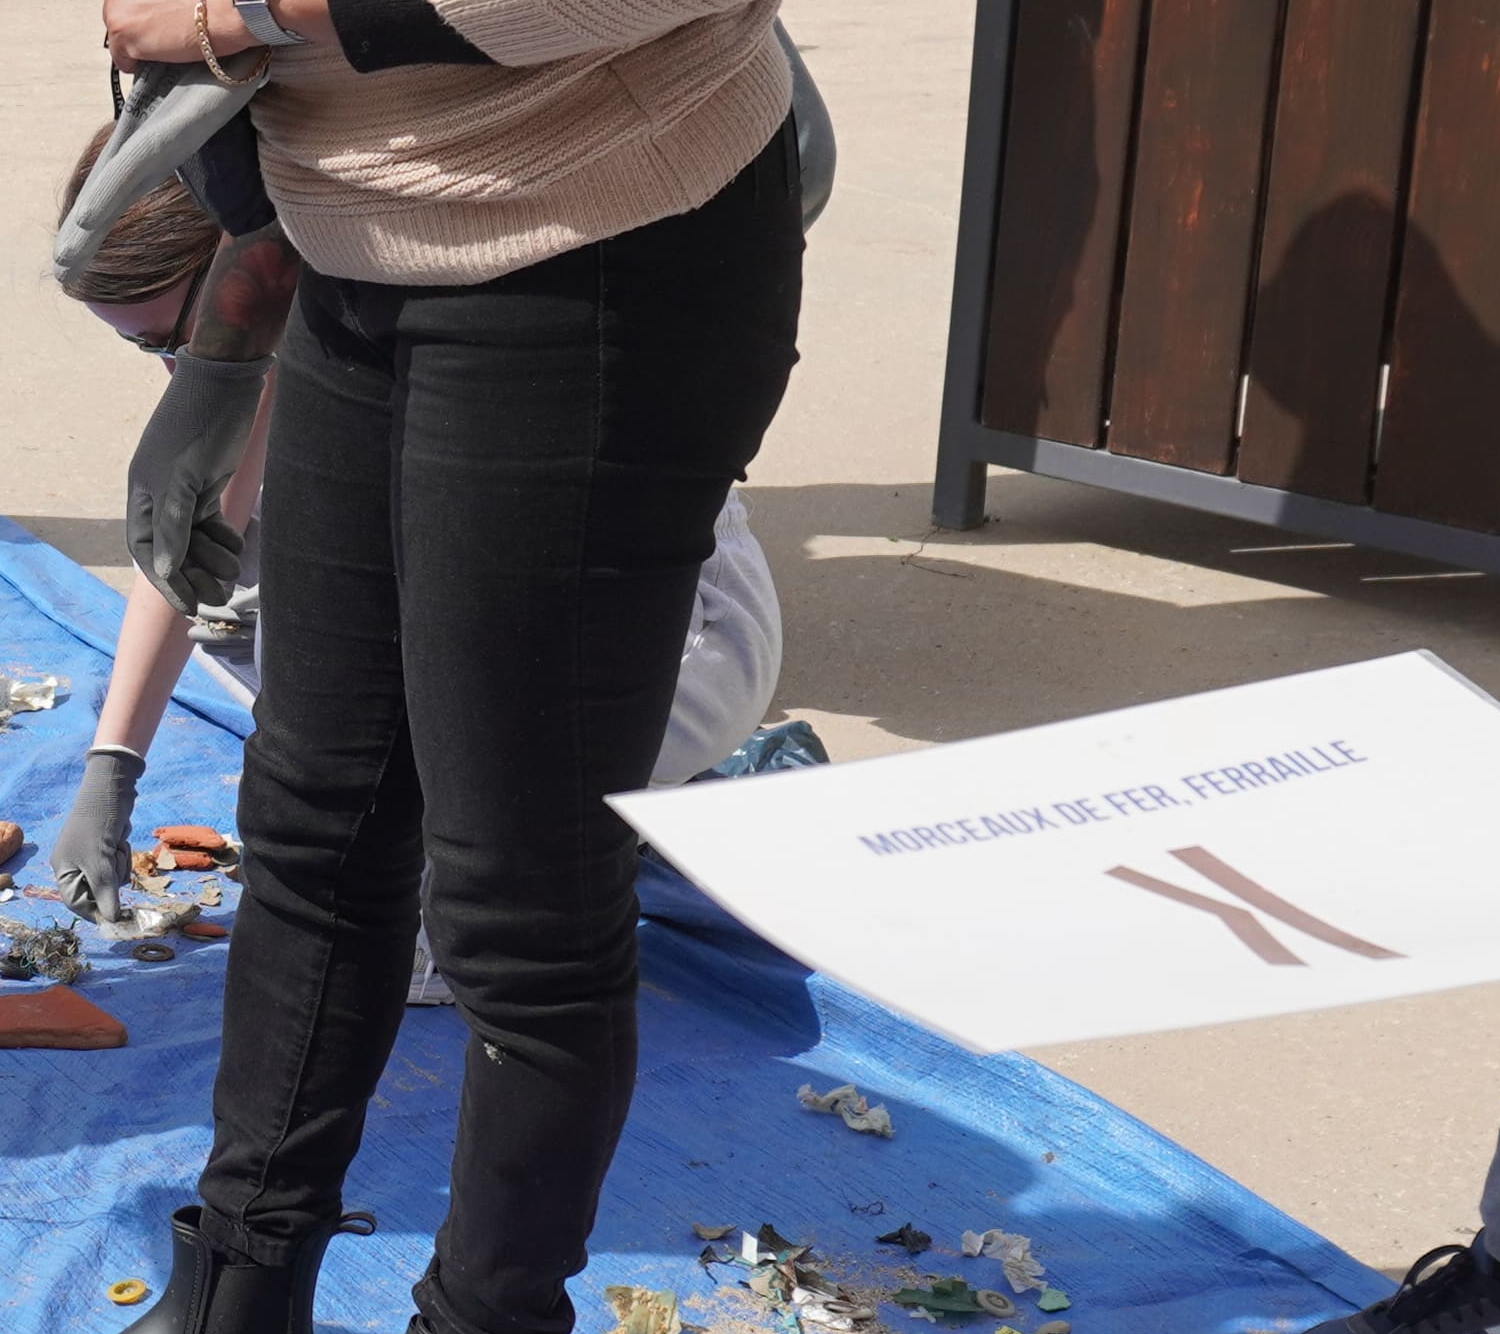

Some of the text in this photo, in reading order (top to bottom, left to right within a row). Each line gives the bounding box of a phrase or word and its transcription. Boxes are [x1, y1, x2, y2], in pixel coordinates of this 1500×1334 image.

[858, 739, 1368, 857] MORCEAUX DE FER, FERRAILLE
